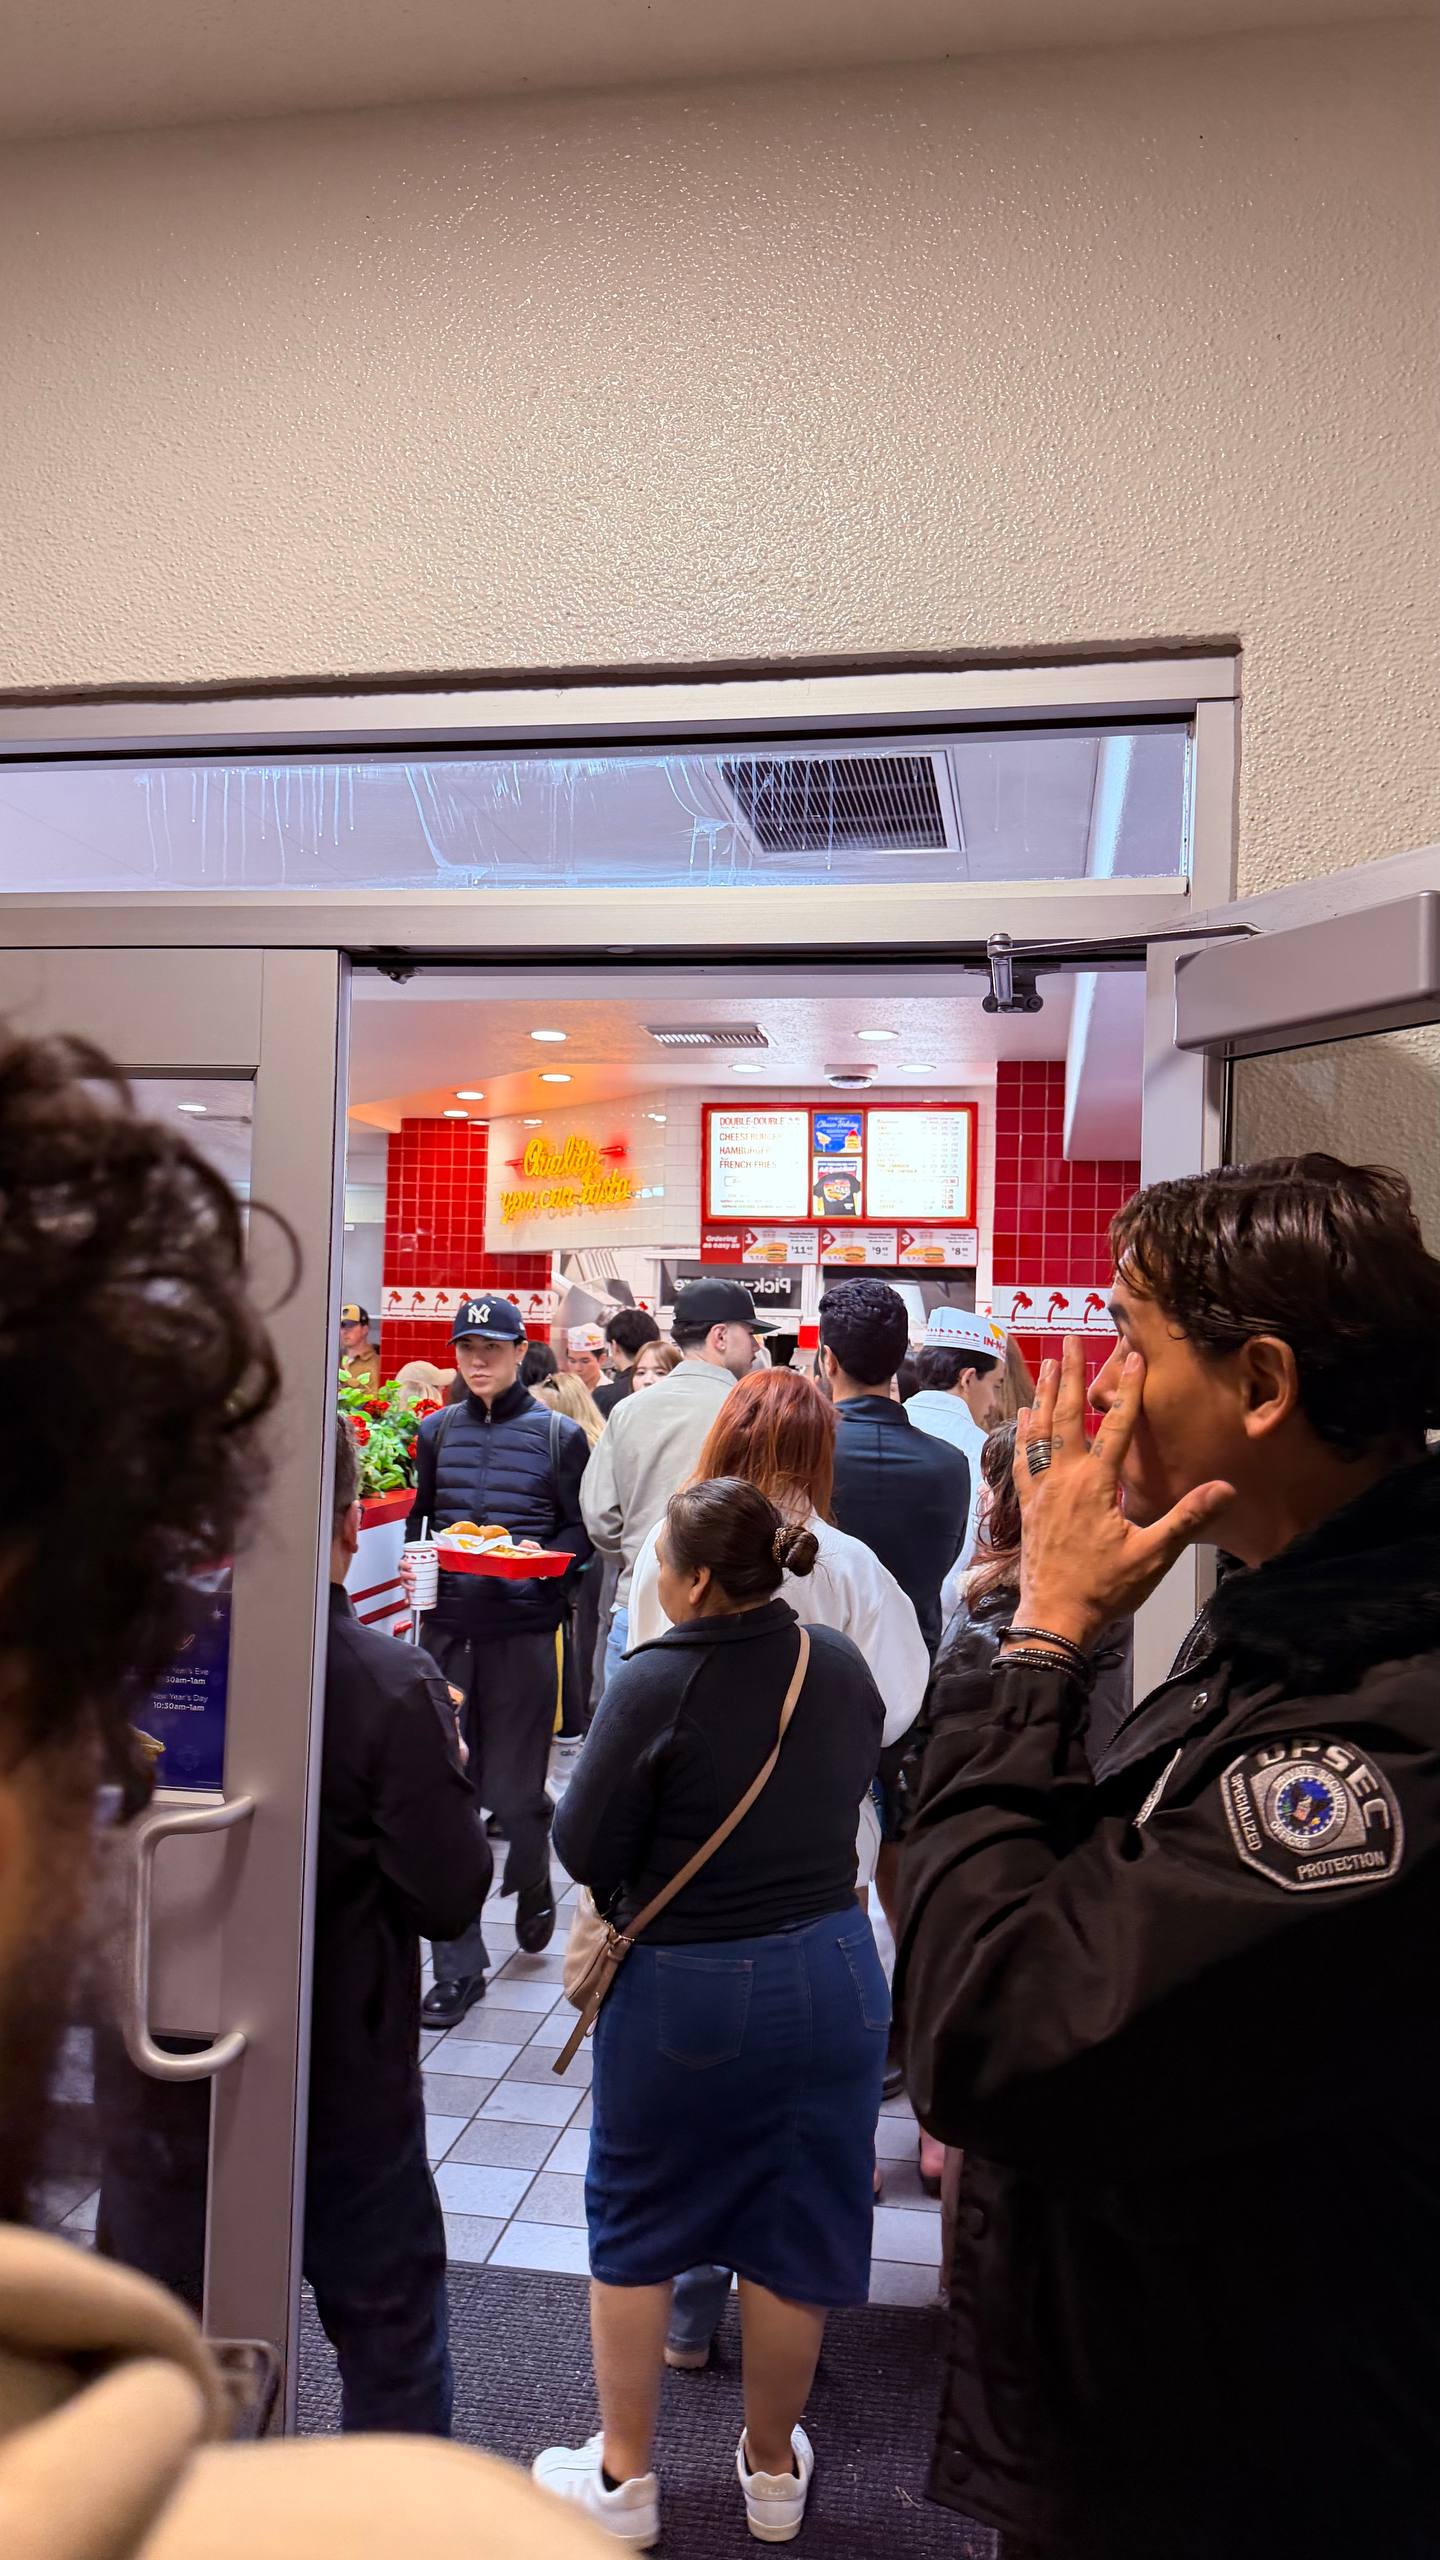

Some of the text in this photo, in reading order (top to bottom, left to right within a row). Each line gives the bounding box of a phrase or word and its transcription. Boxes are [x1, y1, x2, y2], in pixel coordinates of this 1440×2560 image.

[719, 1116, 785, 1126] DOUBLE-DOUBLE
[523, 1134, 606, 1177] Quality
[719, 1160, 751, 1169] FRENCH
[500, 1169, 632, 1224] you can taste
[705, 1235, 738, 1243] Ordering
[744, 1233, 754, 1244] 1
[822, 1234, 832, 1245] 2
[901, 1234, 911, 1245] 3
[467, 1303, 491, 1324] NY
[193, 1694, 209, 1704] Day
[153, 1701, 205, 1711] 10:30am-1am
[1273, 1765, 1315, 1789] PRIVATE
[1230, 1772, 1263, 1851] SPECIALIZED
[1269, 1820, 1312, 1850] OFFICER
[1296, 1850, 1387, 1881] PROTECTION
